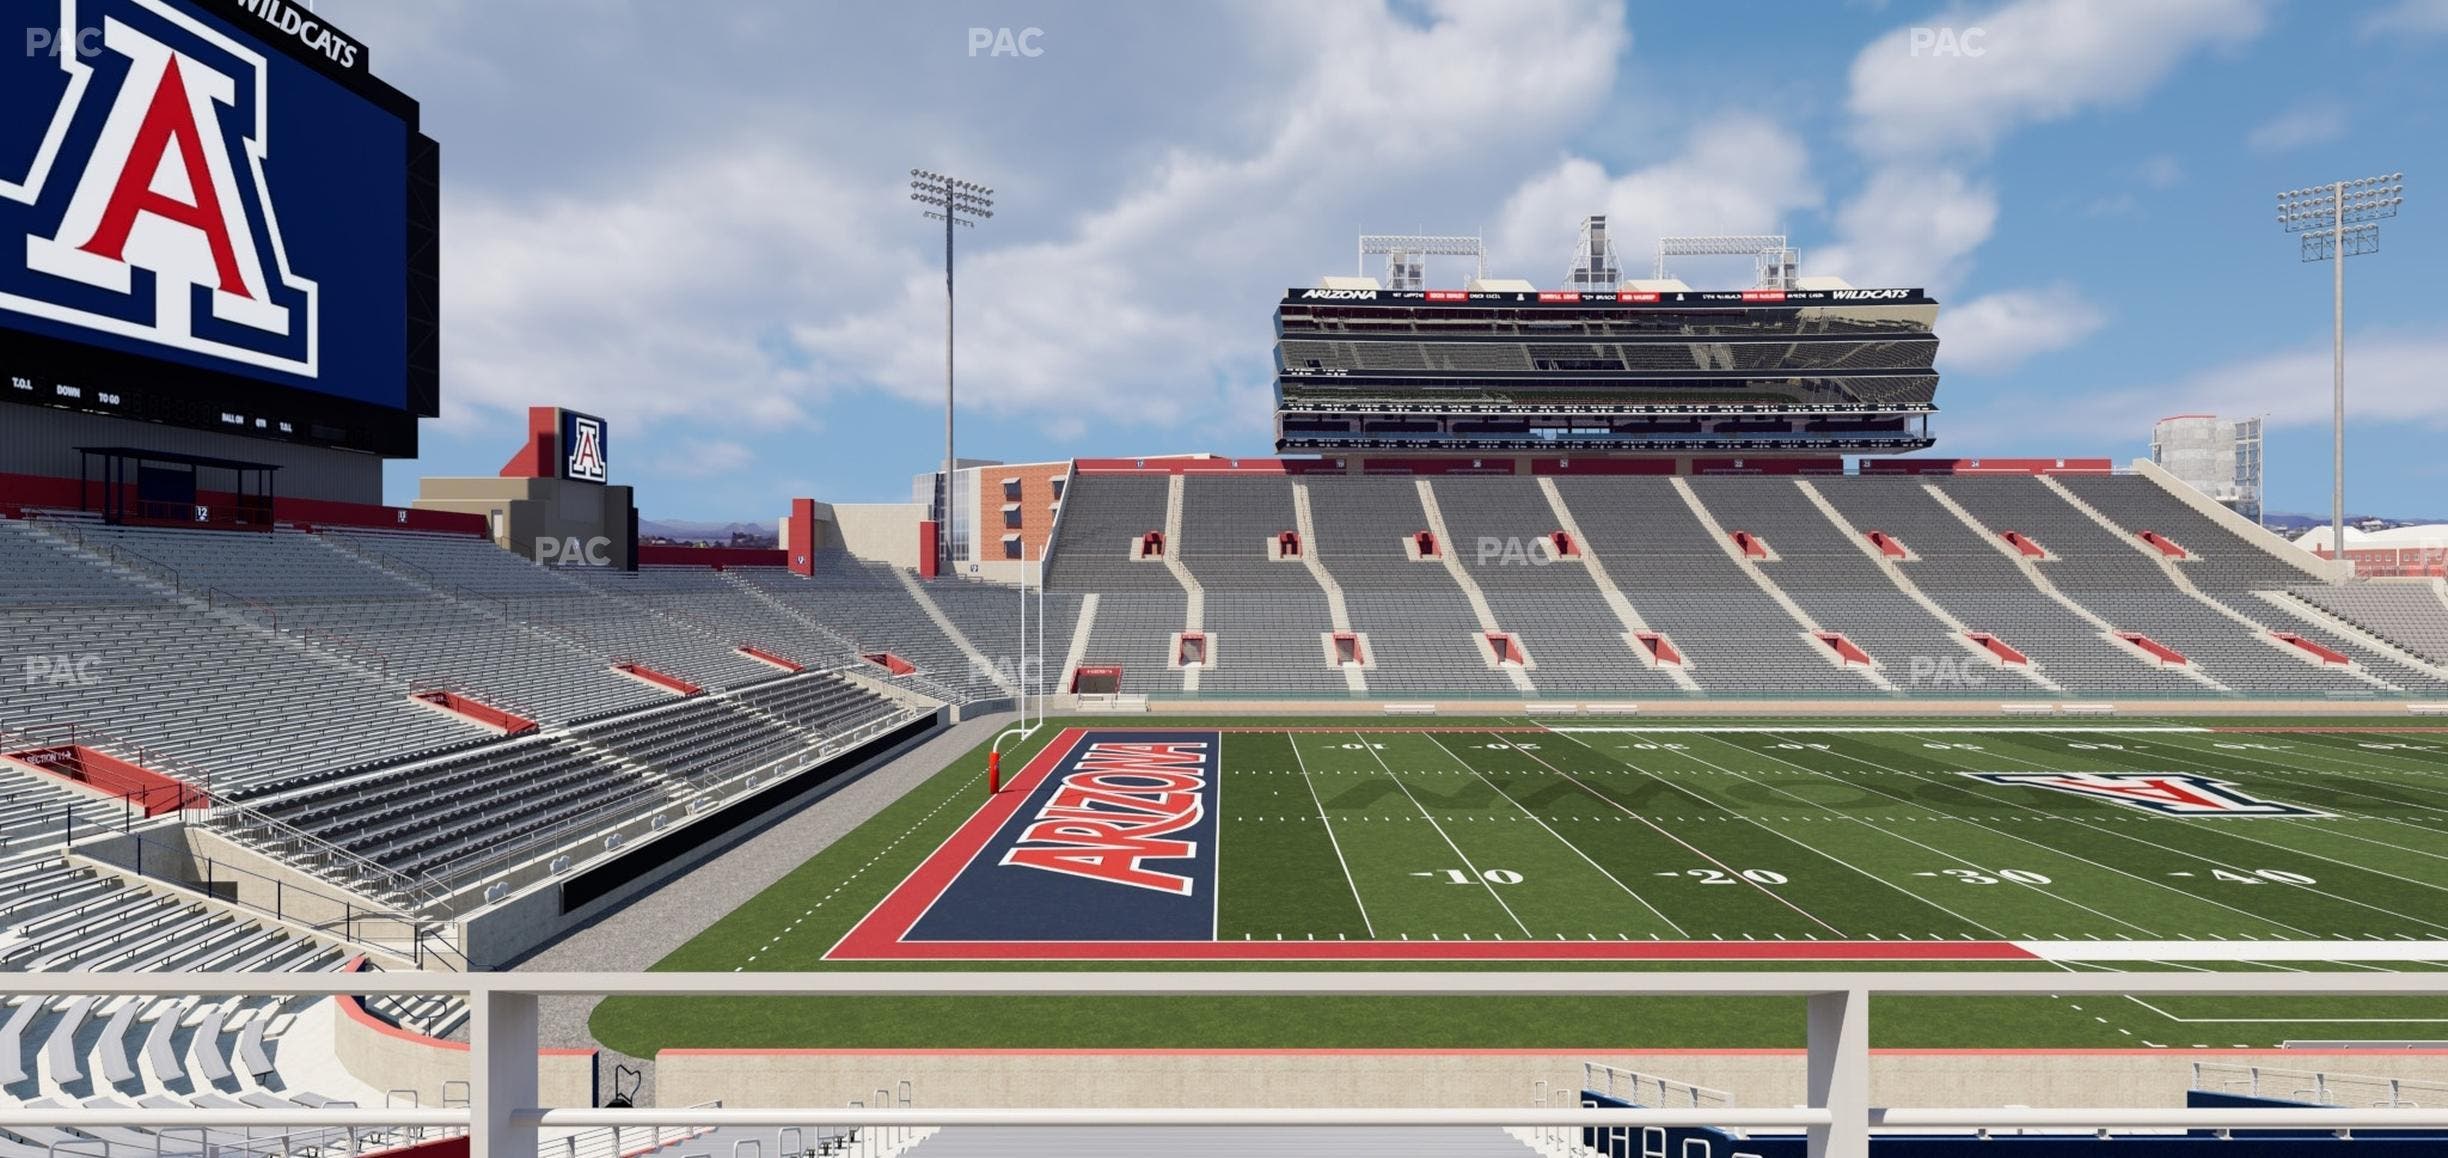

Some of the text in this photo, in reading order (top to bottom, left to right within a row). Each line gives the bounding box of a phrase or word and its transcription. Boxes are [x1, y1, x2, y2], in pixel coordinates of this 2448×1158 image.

[1301, 289, 1376, 300] ARIZONA
[1832, 289, 1910, 300] WILDCATS
[56, 384, 81, 398] DOWN
[98, 392, 120, 405] TO GO
[197, 506, 208, 517] 12
[27, 752, 57, 765] SECTION
[997, 742, 1208, 896] ARIZONA
[1436, 868, 1524, 884] 10
[1686, 868, 1788, 885] 20
[1942, 868, 2052, 884] 30
[2211, 868, 2317, 885] 40
